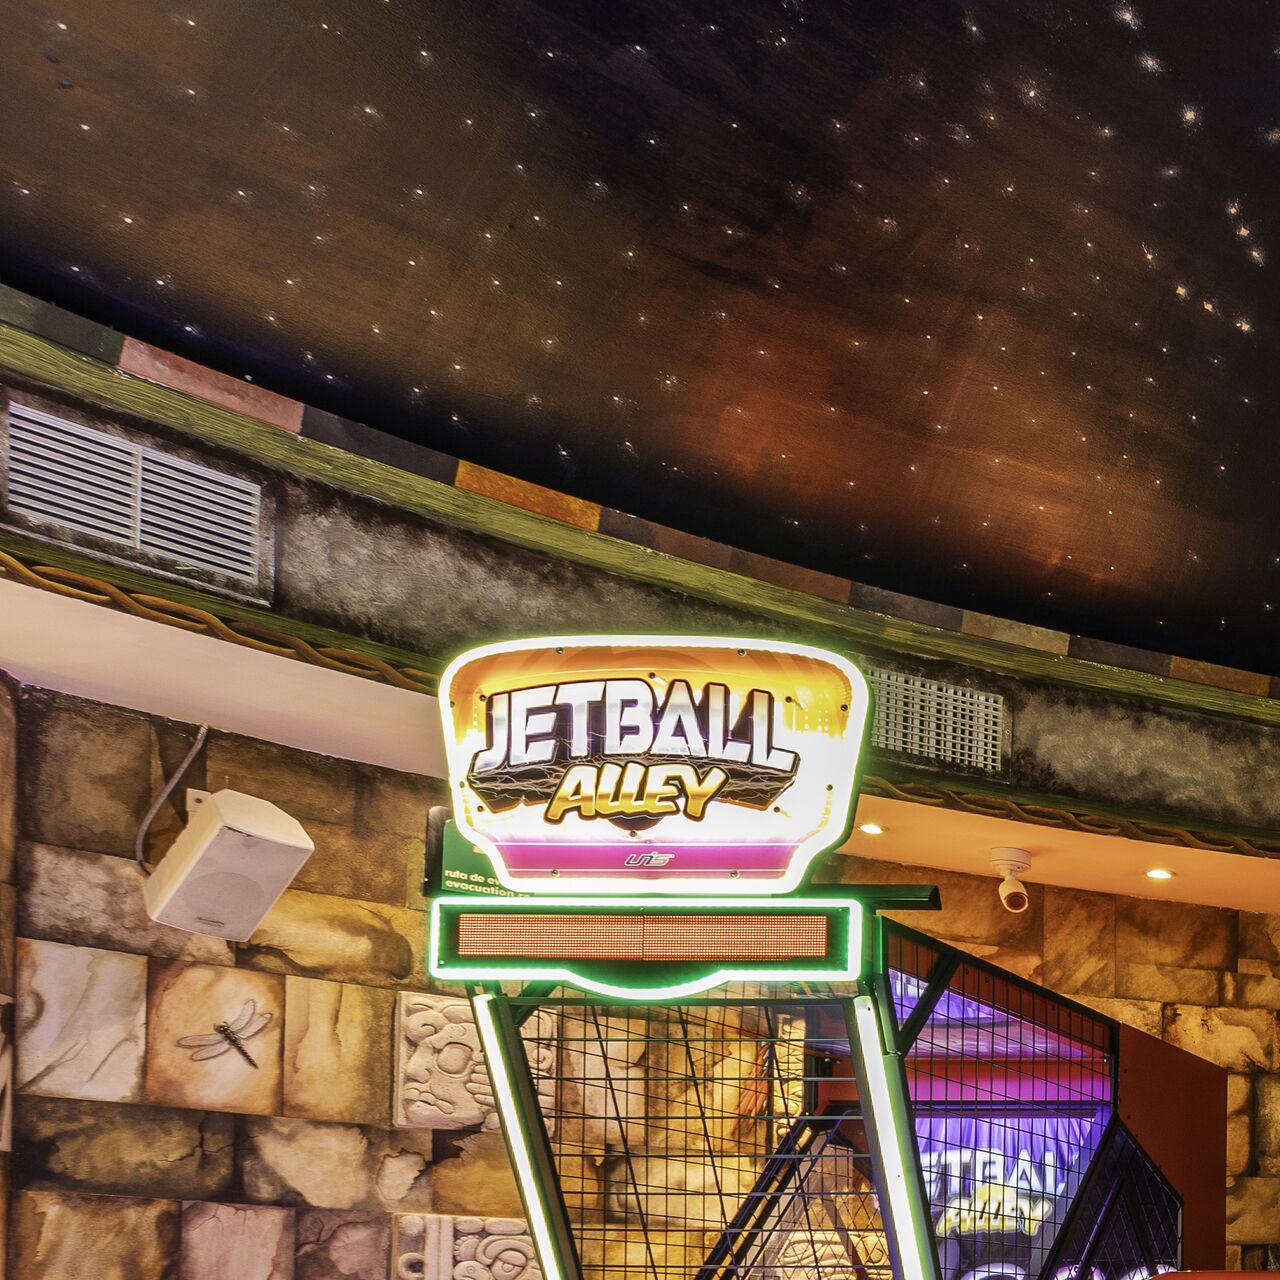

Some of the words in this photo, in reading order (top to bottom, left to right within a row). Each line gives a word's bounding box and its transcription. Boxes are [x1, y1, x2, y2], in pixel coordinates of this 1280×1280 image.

[472, 680, 799, 773] JETBALL
[545, 762, 728, 824] ALLEY
[446, 880, 514, 897] evacuation
[469, 873, 485, 882] de
